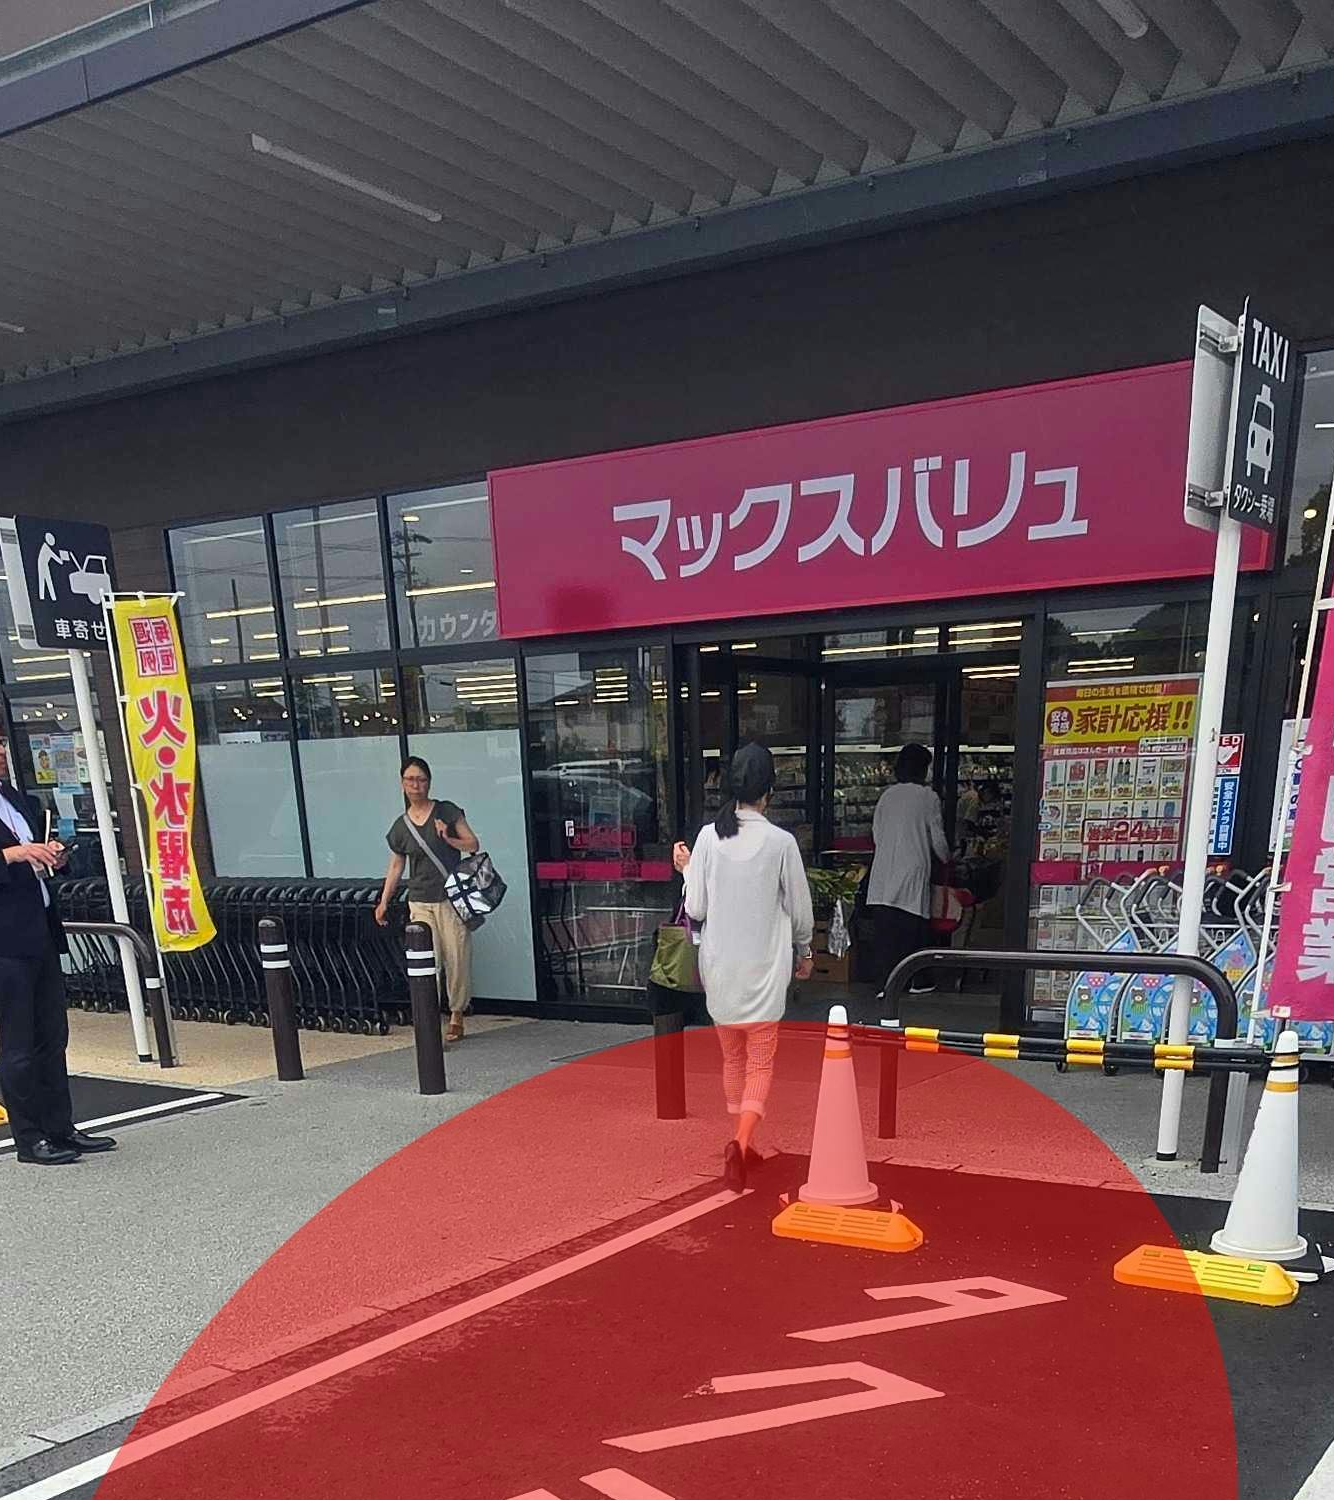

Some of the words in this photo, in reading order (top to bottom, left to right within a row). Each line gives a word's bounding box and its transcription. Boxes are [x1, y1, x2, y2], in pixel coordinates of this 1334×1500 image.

[1252, 317, 1290, 383] TAXI
[613, 450, 1090, 581] マックスバリュ
[54, 617, 107, 641] 車寄せ
[1074, 700, 1194, 735] 家計応援!!
[1220, 736, 1241, 746] ED
